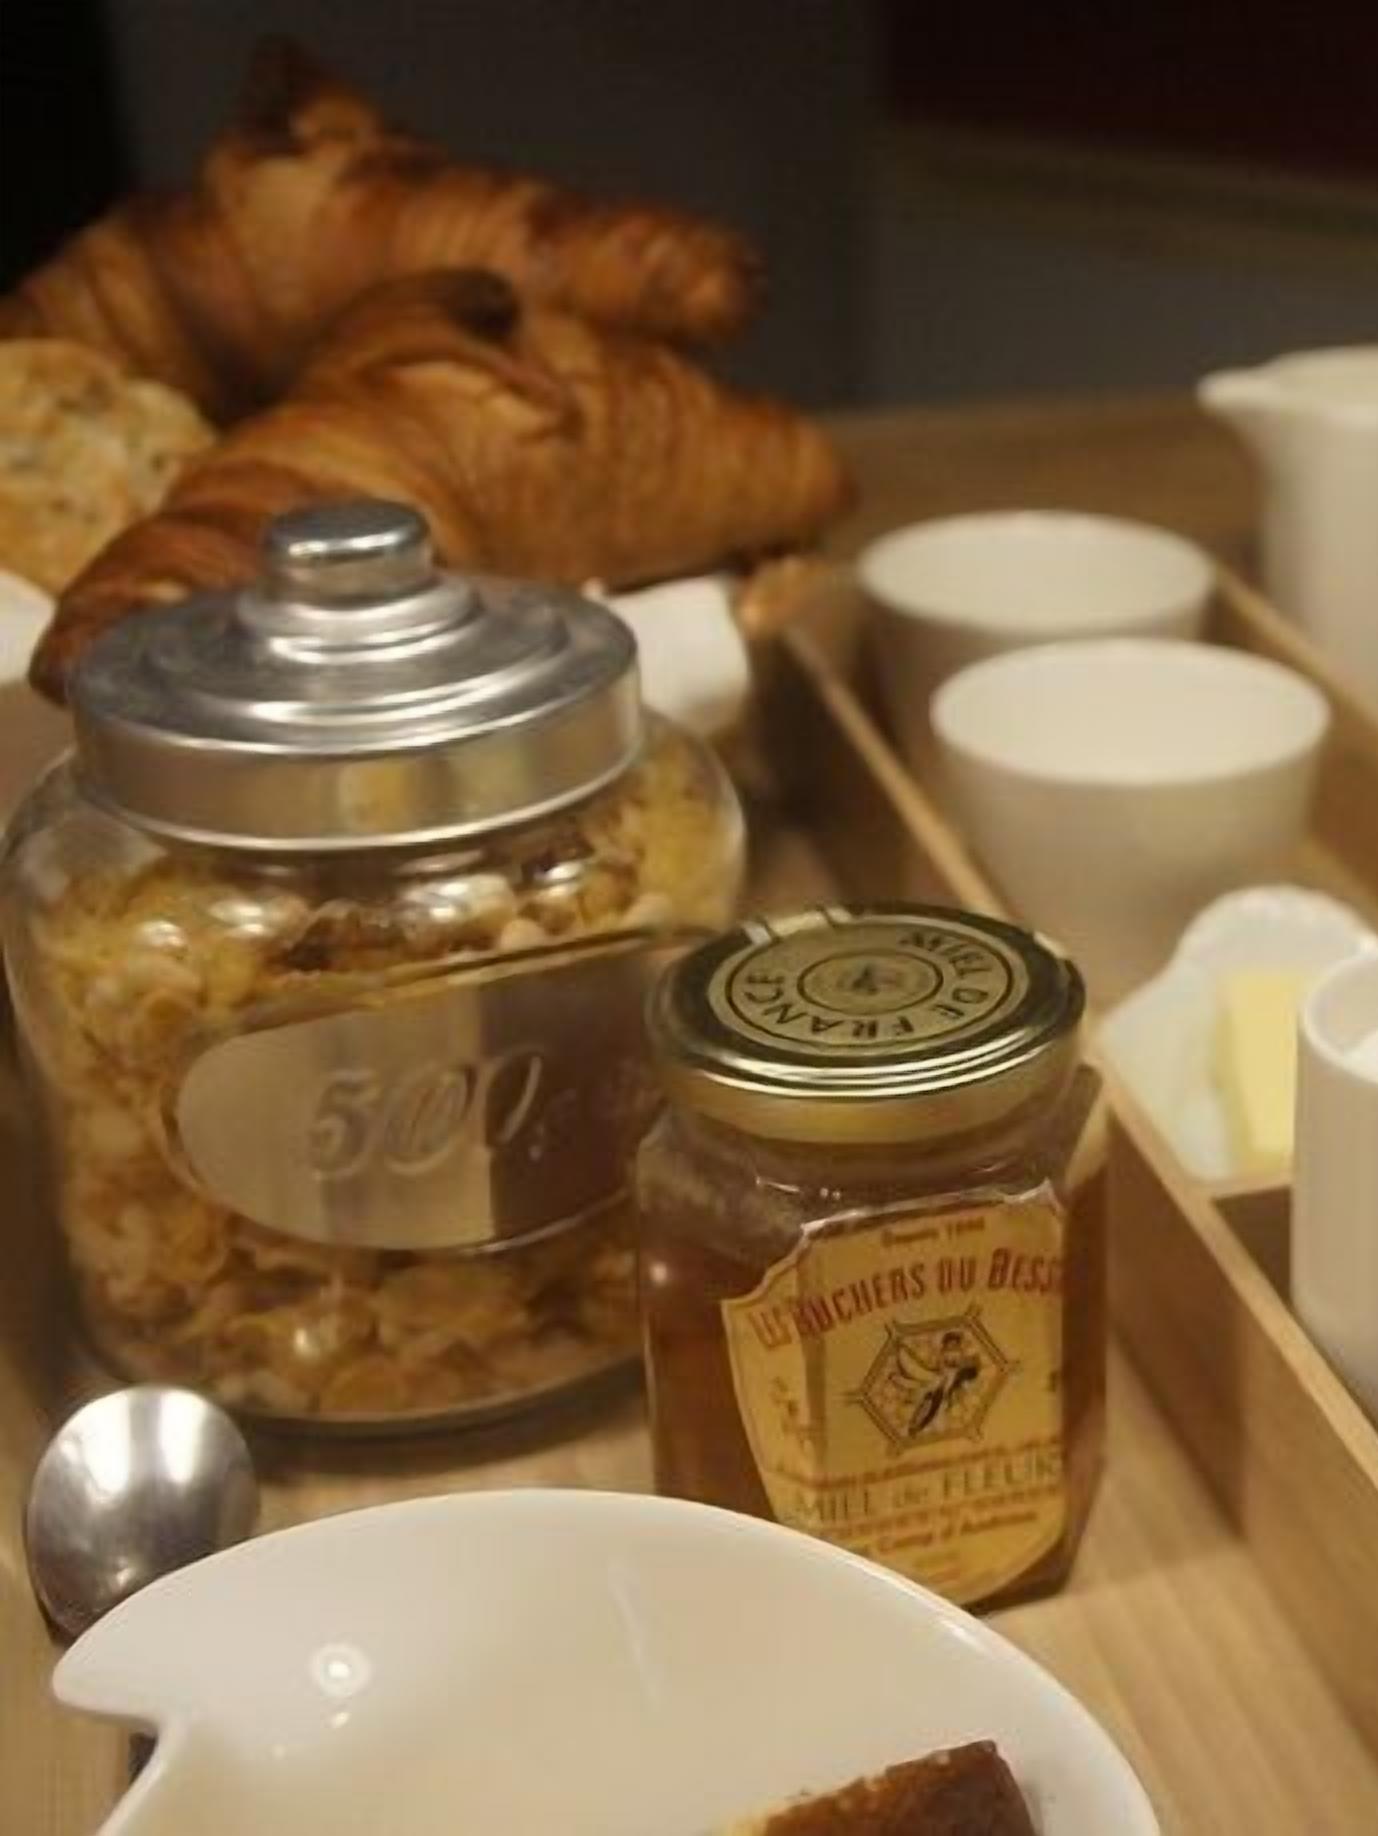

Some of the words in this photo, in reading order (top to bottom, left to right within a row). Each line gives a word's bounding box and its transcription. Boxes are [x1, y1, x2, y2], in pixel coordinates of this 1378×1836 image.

[898, 930, 994, 978] MIEL
[743, 972, 916, 1040] FRANCE
[927, 986, 990, 1020] DE
[937, 1255, 978, 1297] DU
